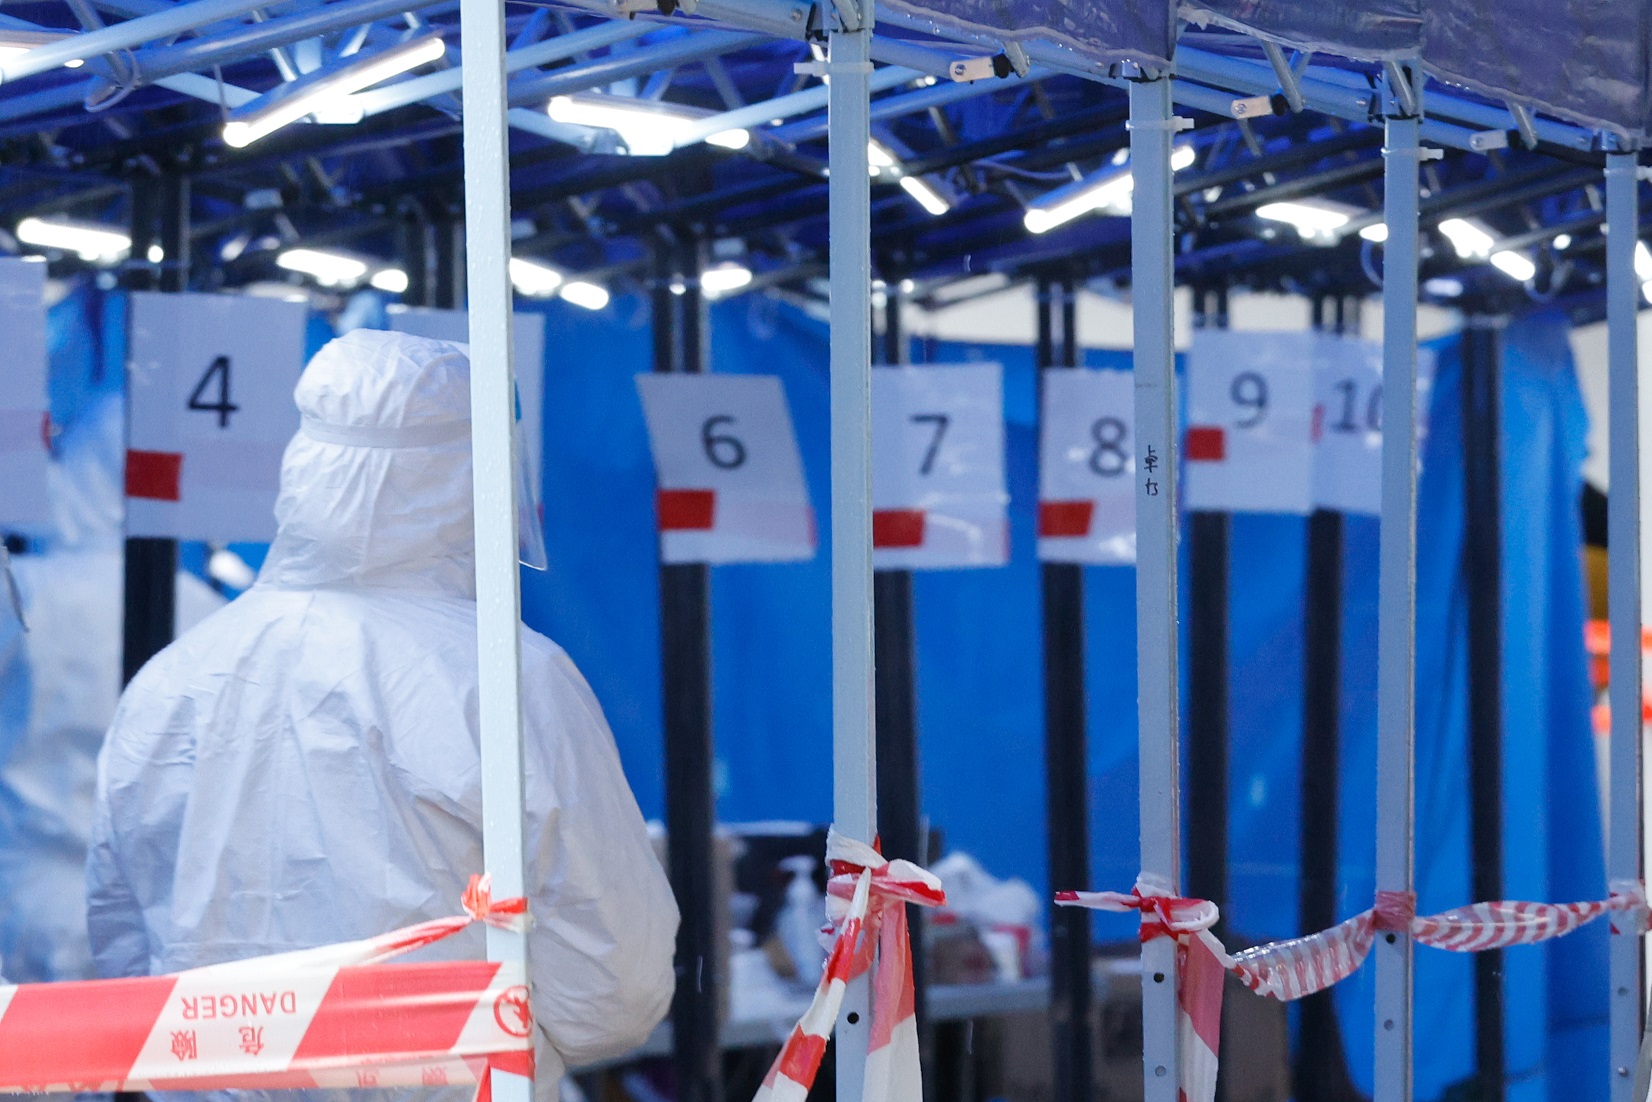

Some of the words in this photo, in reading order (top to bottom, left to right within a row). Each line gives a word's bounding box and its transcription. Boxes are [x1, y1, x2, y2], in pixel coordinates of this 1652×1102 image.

[187, 355, 240, 428] 4
[1230, 371, 1270, 428] 9
[701, 414, 747, 470] 6
[910, 413, 951, 475] 7
[1088, 416, 1128, 477] 8
[182, 991, 296, 1019] DANGER
[170, 1025, 264, 1061] 危險
